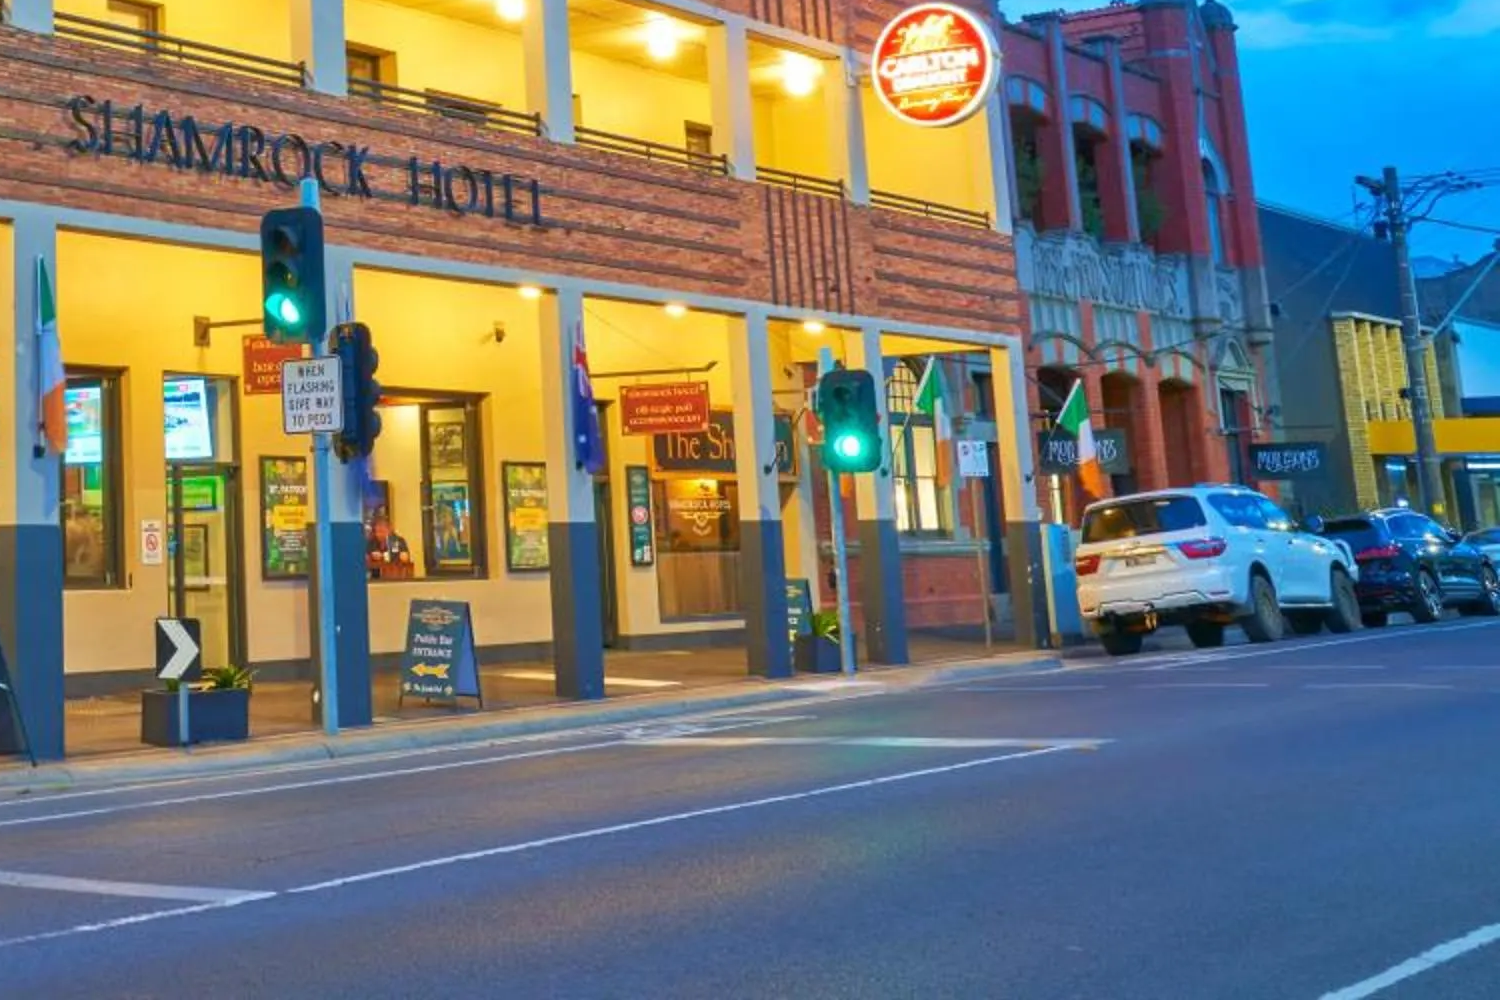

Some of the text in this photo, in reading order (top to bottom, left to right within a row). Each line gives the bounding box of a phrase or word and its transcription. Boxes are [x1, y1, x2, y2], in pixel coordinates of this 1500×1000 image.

[67, 94, 541, 226] SHAMROCK HOTEL
[297, 364, 325, 378] WHEN
[286, 380, 335, 395] FLASHING
[288, 396, 334, 411] GIVE WAY
[292, 415, 305, 427] TO
[667, 431, 700, 459] The
